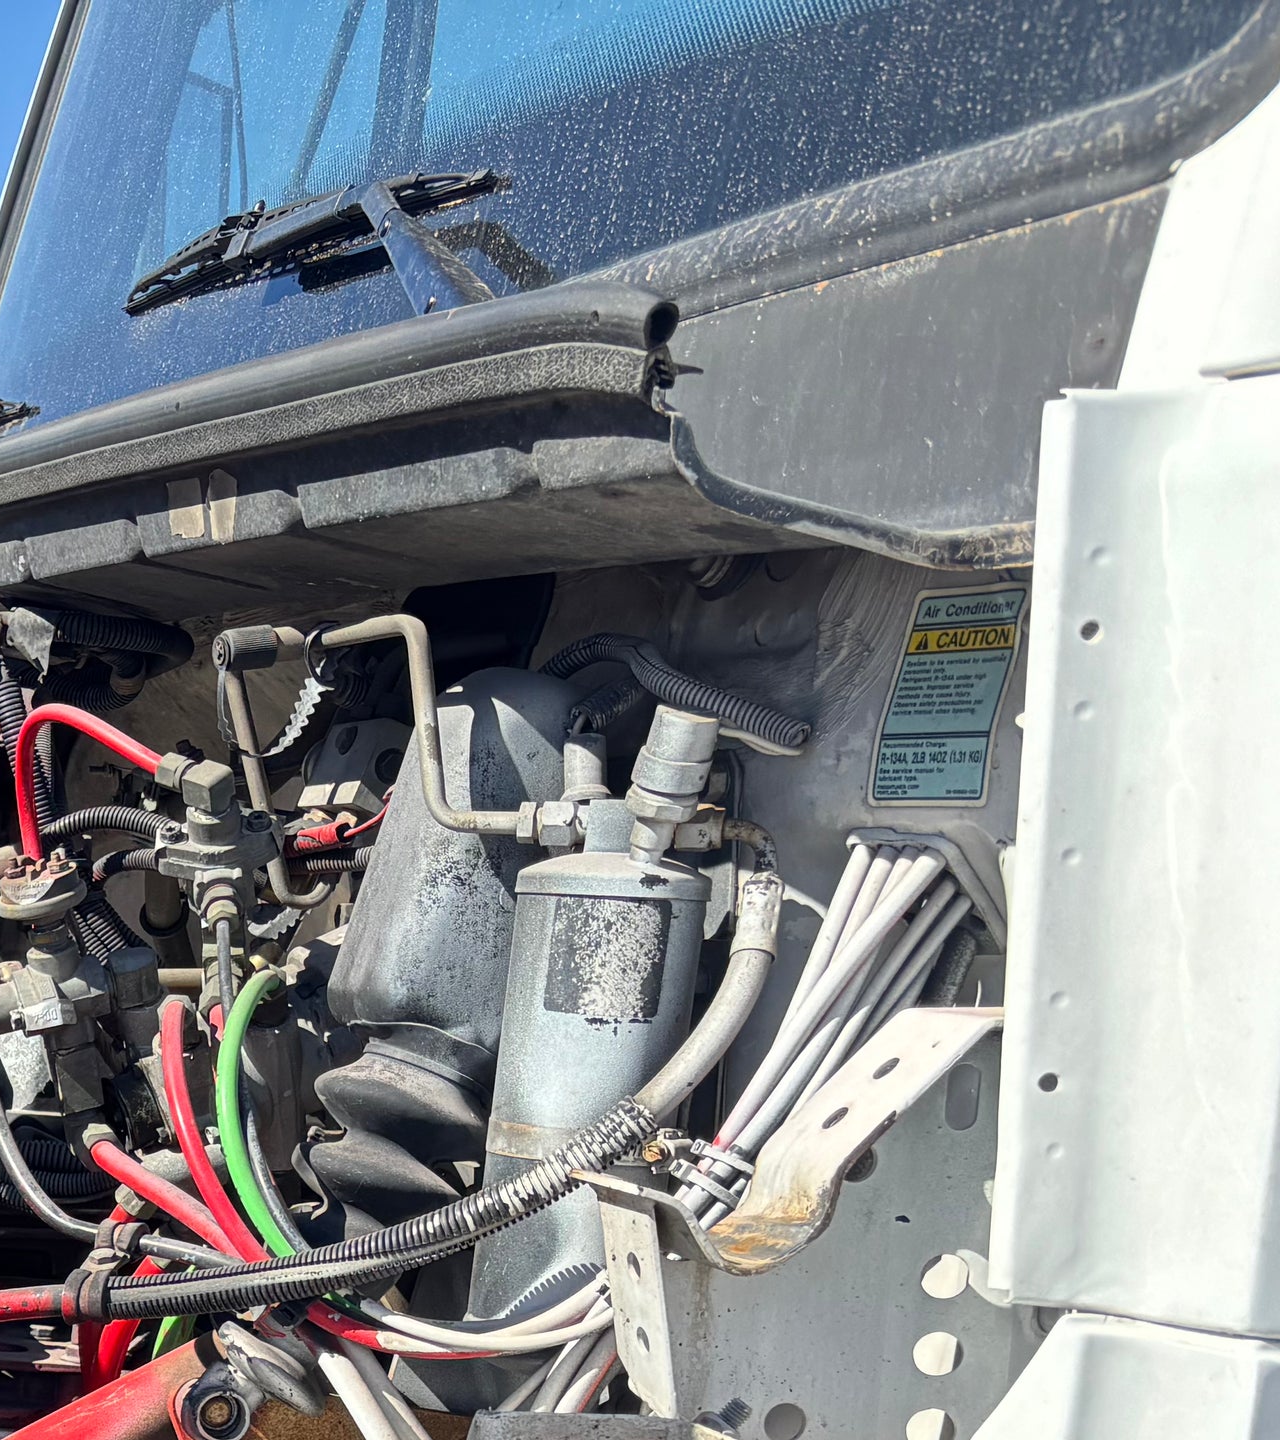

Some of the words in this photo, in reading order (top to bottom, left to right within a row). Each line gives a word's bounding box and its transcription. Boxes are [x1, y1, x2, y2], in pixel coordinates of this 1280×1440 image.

[923, 605, 941, 619] Air
[946, 600, 1016, 617] Conditioner
[936, 628, 1011, 648] CAUTION
[911, 751, 926, 764] 2LB
[949, 750, 966, 765] (1.31
[968, 749, 983, 764] KG)
